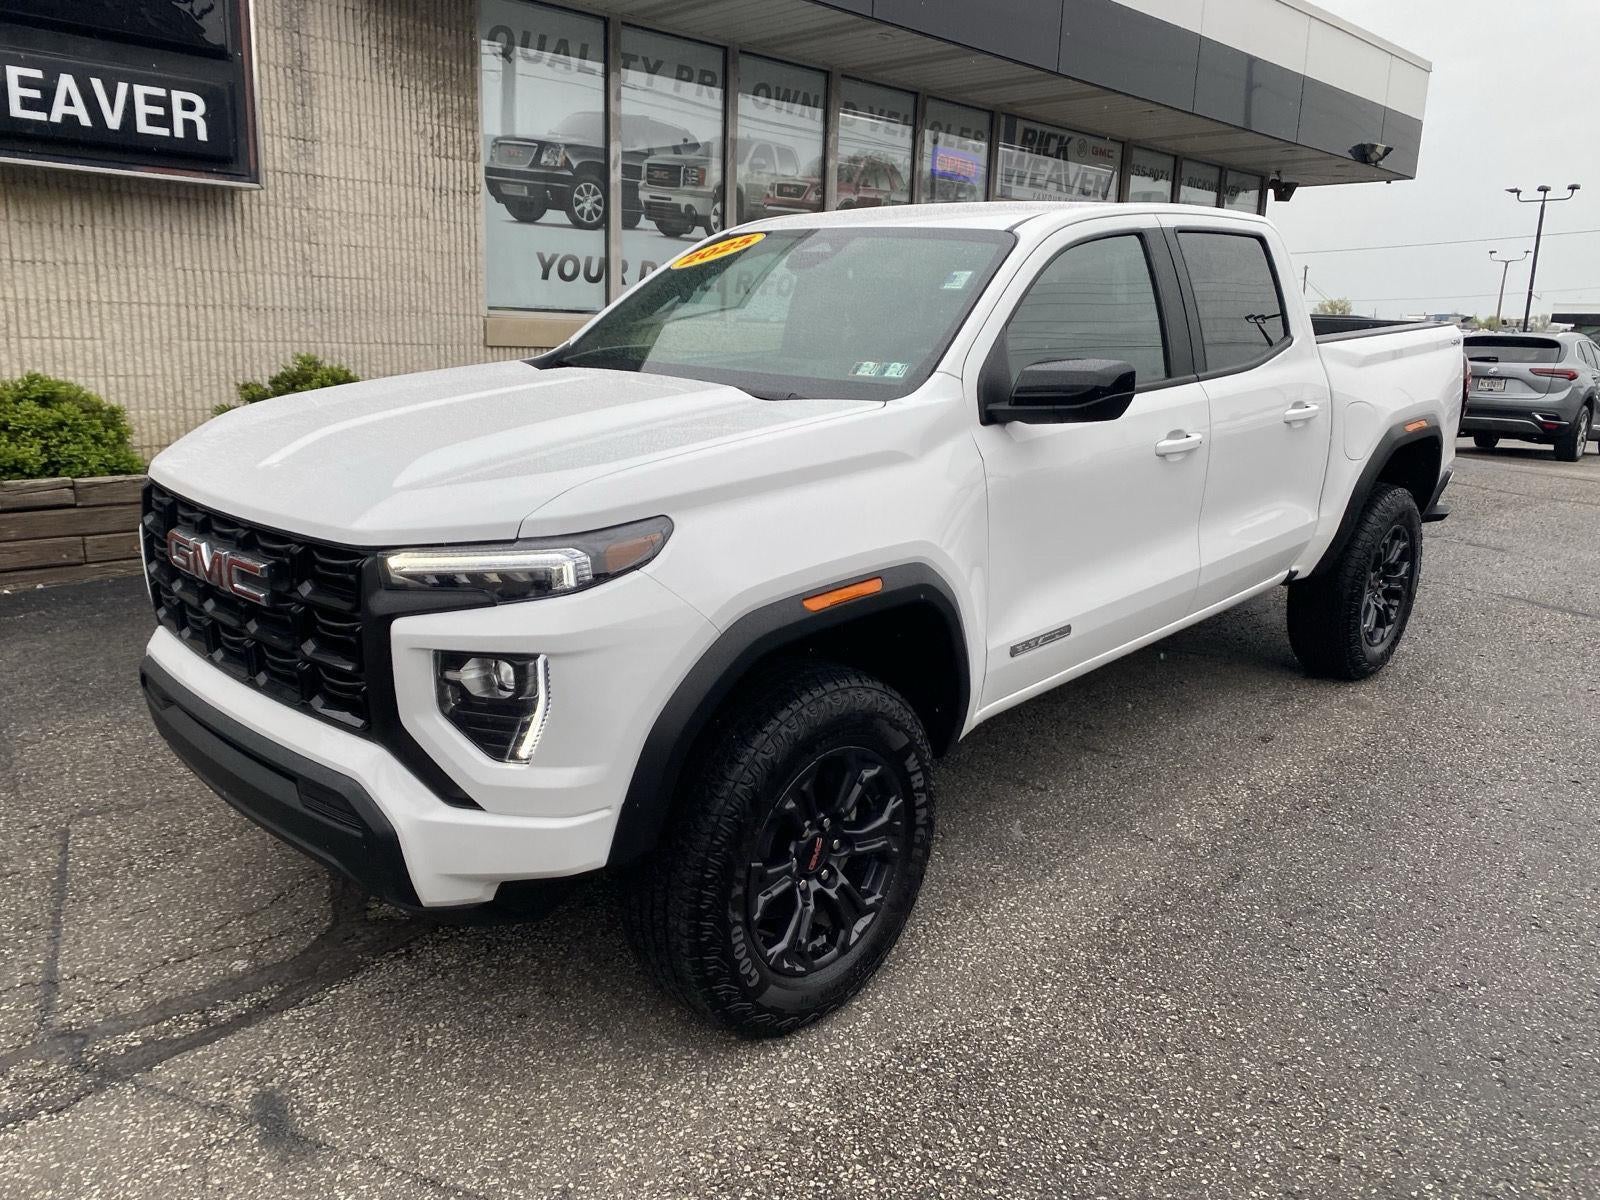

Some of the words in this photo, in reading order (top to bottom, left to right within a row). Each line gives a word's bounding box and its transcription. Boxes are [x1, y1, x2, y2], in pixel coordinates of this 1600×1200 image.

[5, 65, 208, 142] EAVER
[487, 25, 664, 87] QUALTY
[867, 105, 985, 153] VEHCLES
[937, 154, 977, 177] OPEN
[1021, 127, 1073, 161] RICK
[1092, 145, 1114, 159] GMC
[679, 234, 758, 267] 2025
[167, 527, 271, 607] GMC
